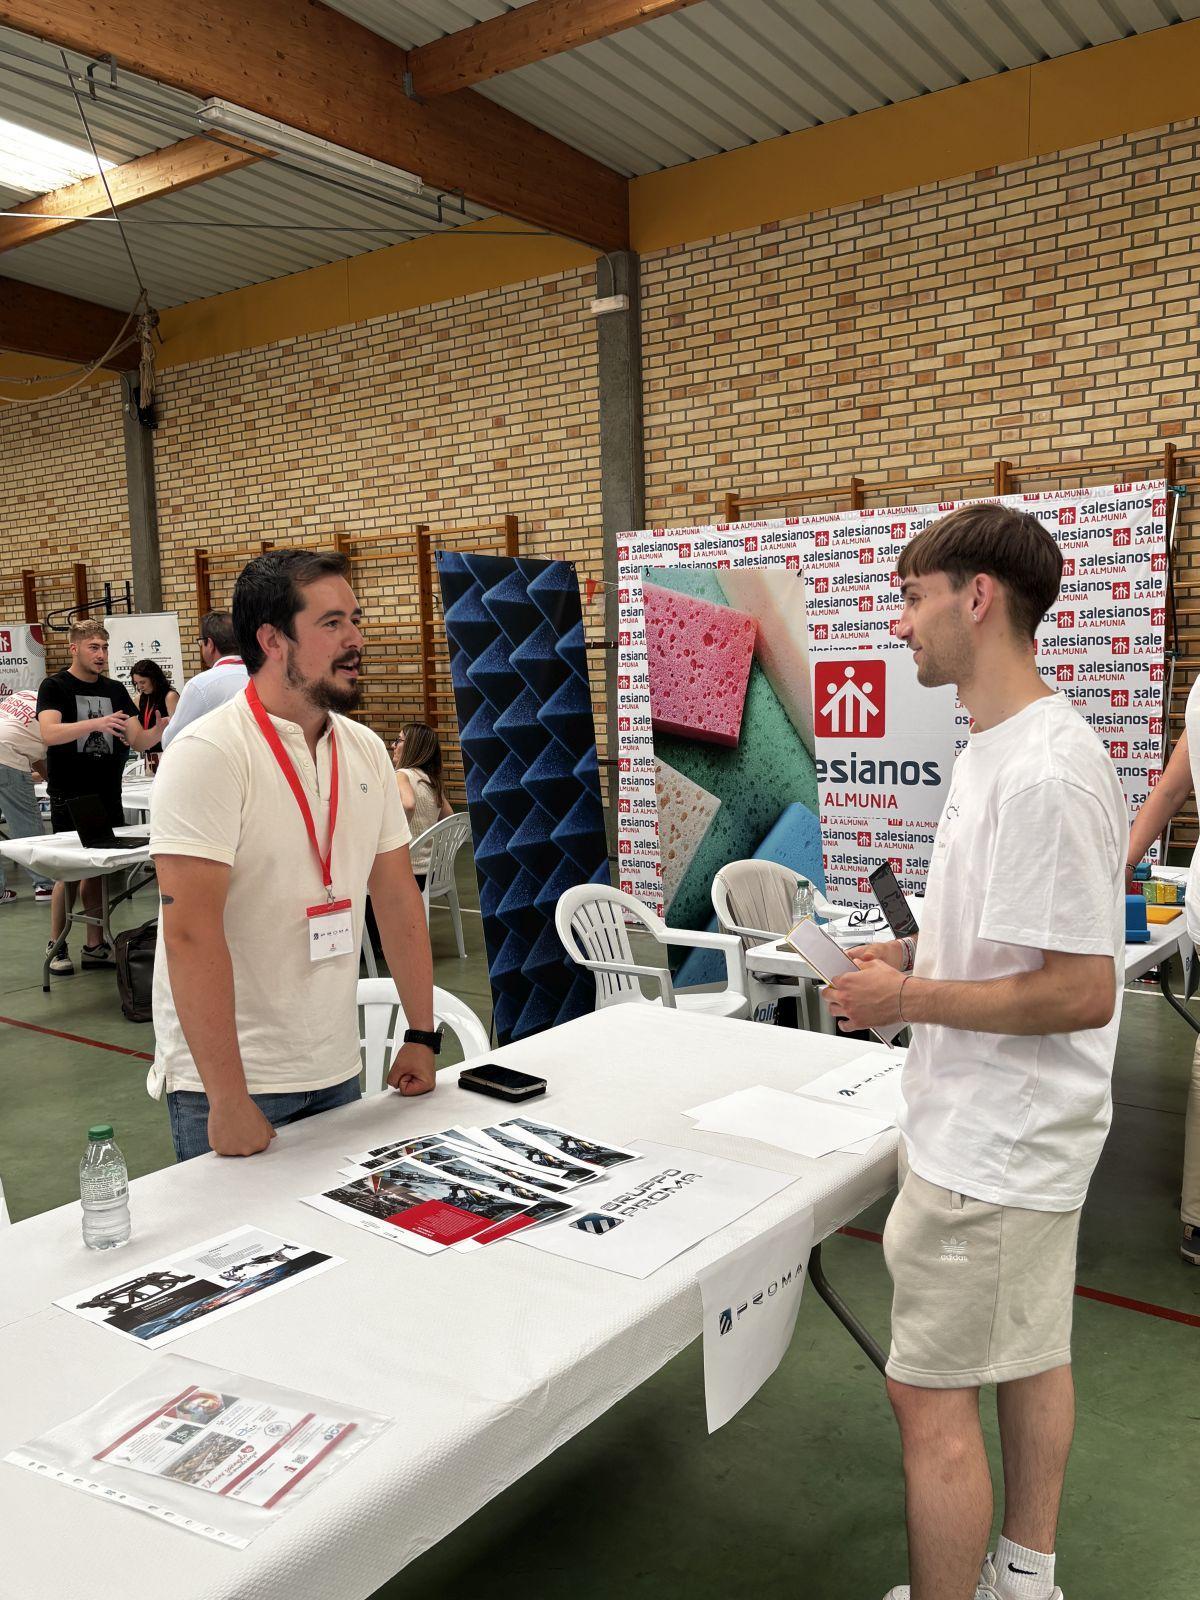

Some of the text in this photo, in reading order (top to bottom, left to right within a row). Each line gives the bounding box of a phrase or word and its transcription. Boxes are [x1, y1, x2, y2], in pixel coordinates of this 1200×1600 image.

[1054, 489, 1090, 499] ALMUNIA
[887, 506, 918, 515] ALMUNIA
[1080, 498, 1153, 515] salesianos
[811, 515, 840, 523] ALMUNIA
[1080, 513, 1127, 524] LA ALMUNIA
[741, 521, 767, 529] ALMUNIA
[833, 523, 891, 538] salesianos
[1136, 522, 1163, 536] sale
[675, 528, 700, 536] ALMUNIA
[761, 530, 815, 543] salesianos
[632, 541, 679, 553] salesianos
[694, 538, 745, 550] salesianos
[769, 542, 797, 550] ALMUNIA
[841, 537, 871, 545] ALMUNIA
[1135, 537, 1144, 545] LA
[733, 554, 786, 567] salesianos
[803, 549, 858, 563] salesianos
[1080, 552, 1151, 567] salesianos
[811, 561, 840, 569] ALMUNIA
[1090, 566, 1127, 574] ALMUNIA
[832, 572, 890, 585] salesianos
[1135, 577, 1162, 590] sale
[1061, 580, 1112, 593] esianos
[1078, 606, 1150, 620] salesianos
[832, 620, 889, 632] salesianos
[1089, 619, 1126, 627] ALMUNIA
[1042, 634, 1112, 647] salesianos
[1134, 633, 1162, 646] sale
[1052, 647, 1088, 655] ALMUNIA
[1078, 660, 1149, 673] salesianos
[1077, 673, 1125, 682] LA ALMUNIA
[1134, 687, 1161, 698] sale
[1133, 739, 1160, 751] sale
[633, 798, 656, 808] sales
[824, 793, 899, 809] ALMUNIA
[621, 817, 655, 828] esianos
[875, 830, 934, 844] salesianos
[622, 858, 655, 869] esianos
[840, 865, 868, 873] ALMUNIA
[600, 1168, 682, 1212] GRUPPO
[618, 1173, 703, 1217] PROMA
[737, 1263, 803, 1320] PROMA
